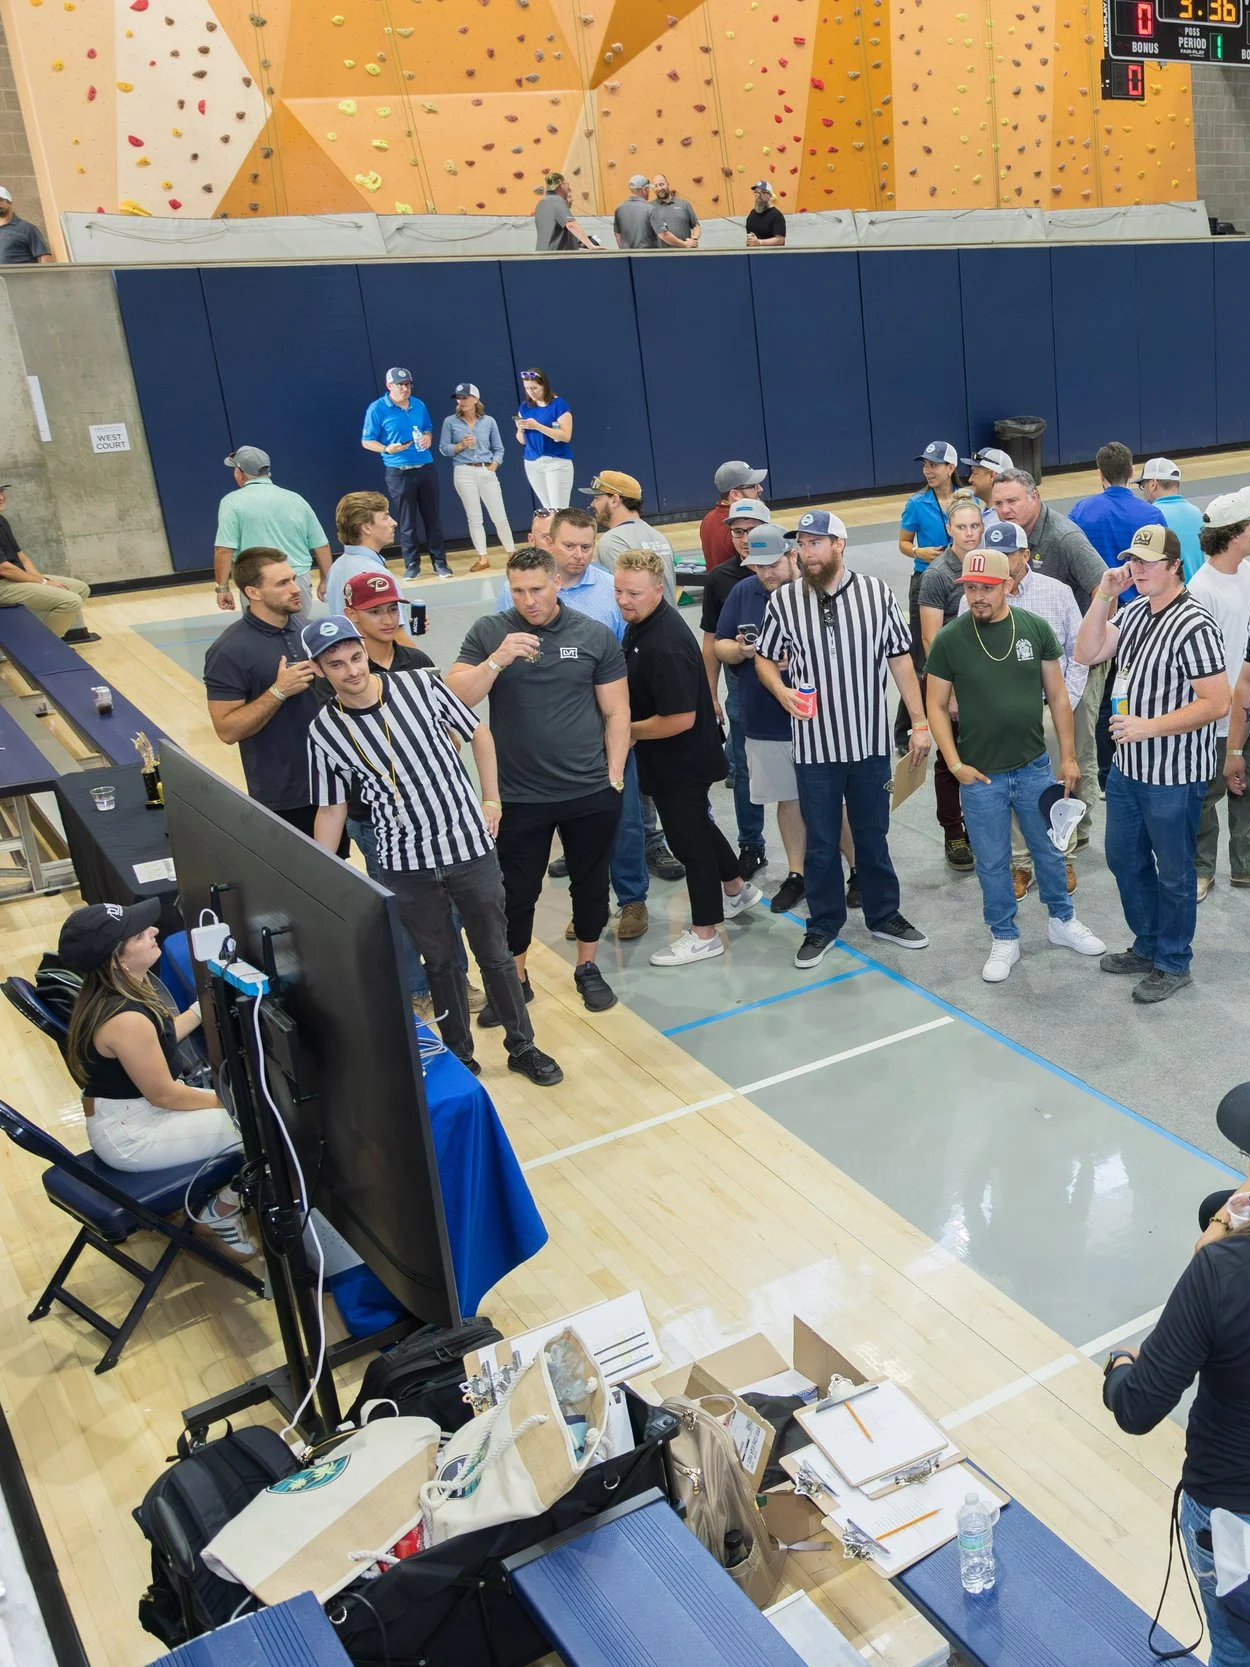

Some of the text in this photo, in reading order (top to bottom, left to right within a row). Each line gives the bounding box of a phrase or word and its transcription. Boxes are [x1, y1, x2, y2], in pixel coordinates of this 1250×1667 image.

[1137, 3, 1153, 34] 0
[1184, 27, 1200, 37] POSS
[1131, 41, 1159, 54] BONUS
[1178, 36, 1207, 50] PERIOD
[1216, 35, 1223, 59] 1
[1127, 64, 1143, 96] 0
[96, 433, 122, 442] WEST
[96, 441, 126, 450] COURT
